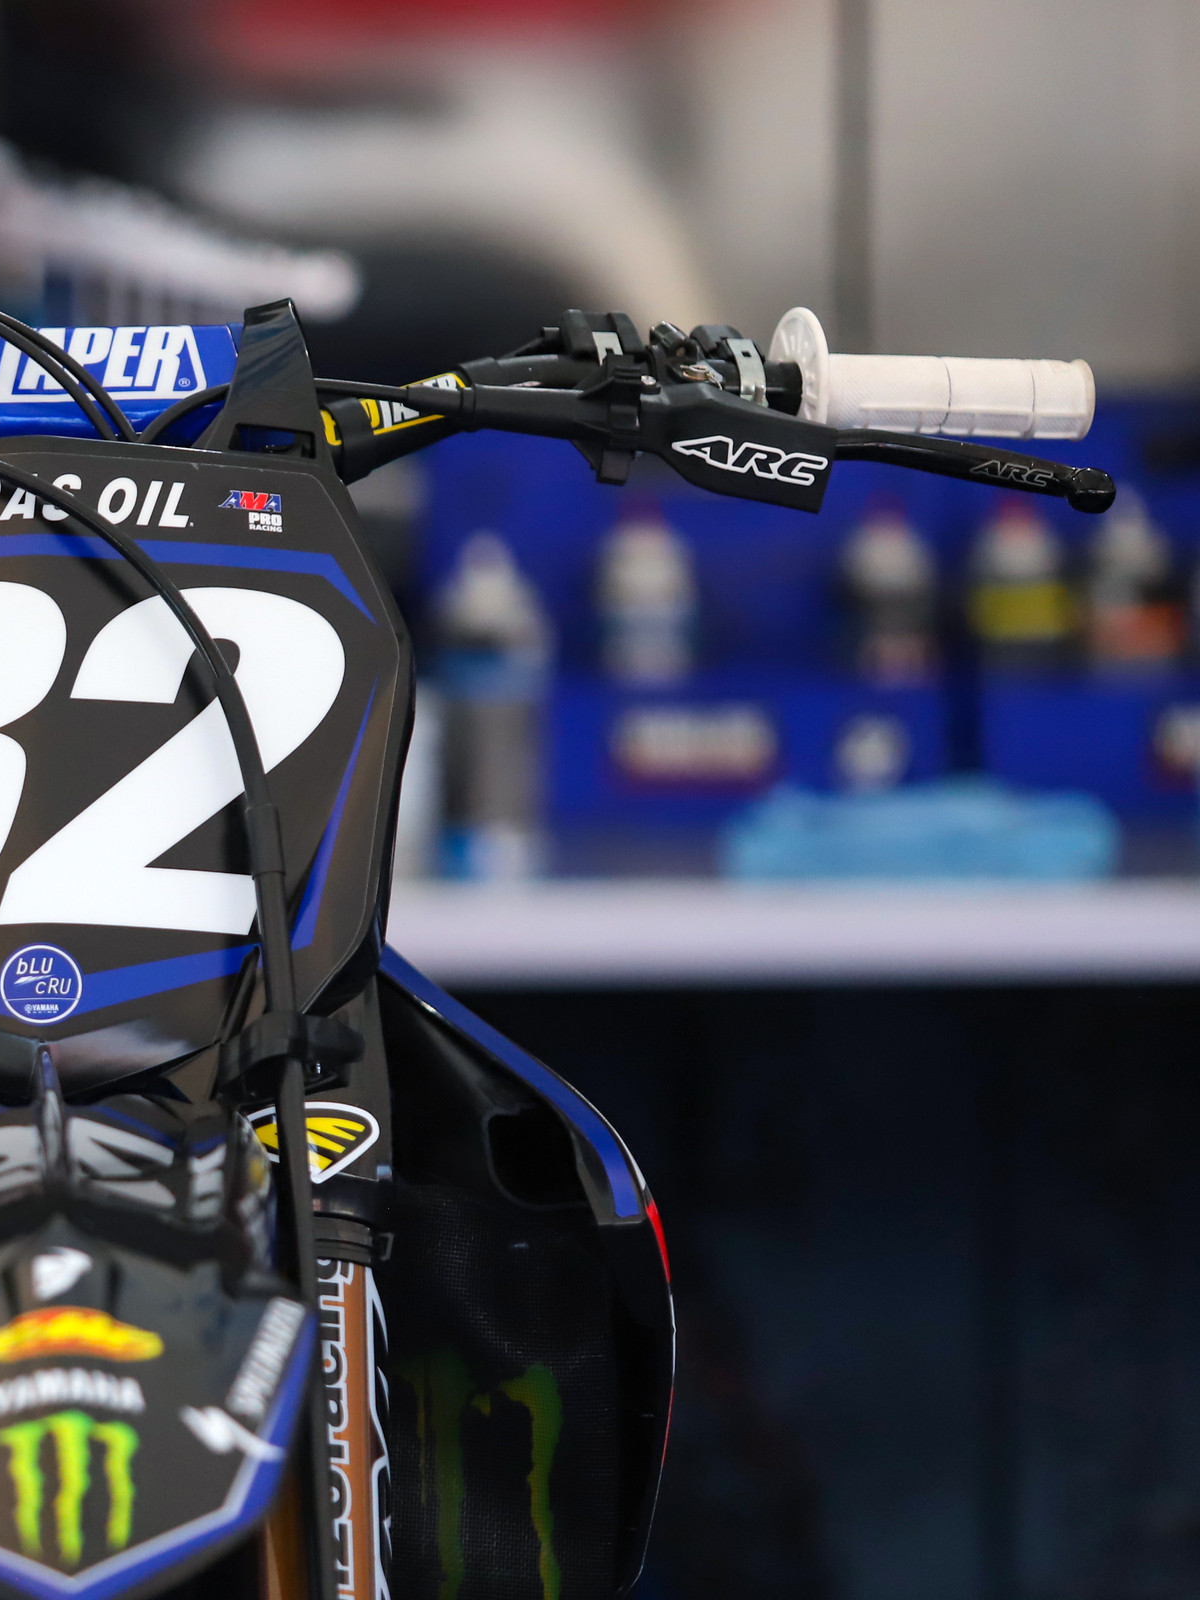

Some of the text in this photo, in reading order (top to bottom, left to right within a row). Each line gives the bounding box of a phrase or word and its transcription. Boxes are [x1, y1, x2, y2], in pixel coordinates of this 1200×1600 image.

[671, 435, 828, 487] ARC
[969, 459, 1054, 488] ARC
[97, 477, 189, 528] OIL
[218, 489, 281, 513] AMA
[248, 511, 283, 526] PRO
[248, 523, 283, 533] RACING
[32, 1003, 59, 1011] YAMAHA
